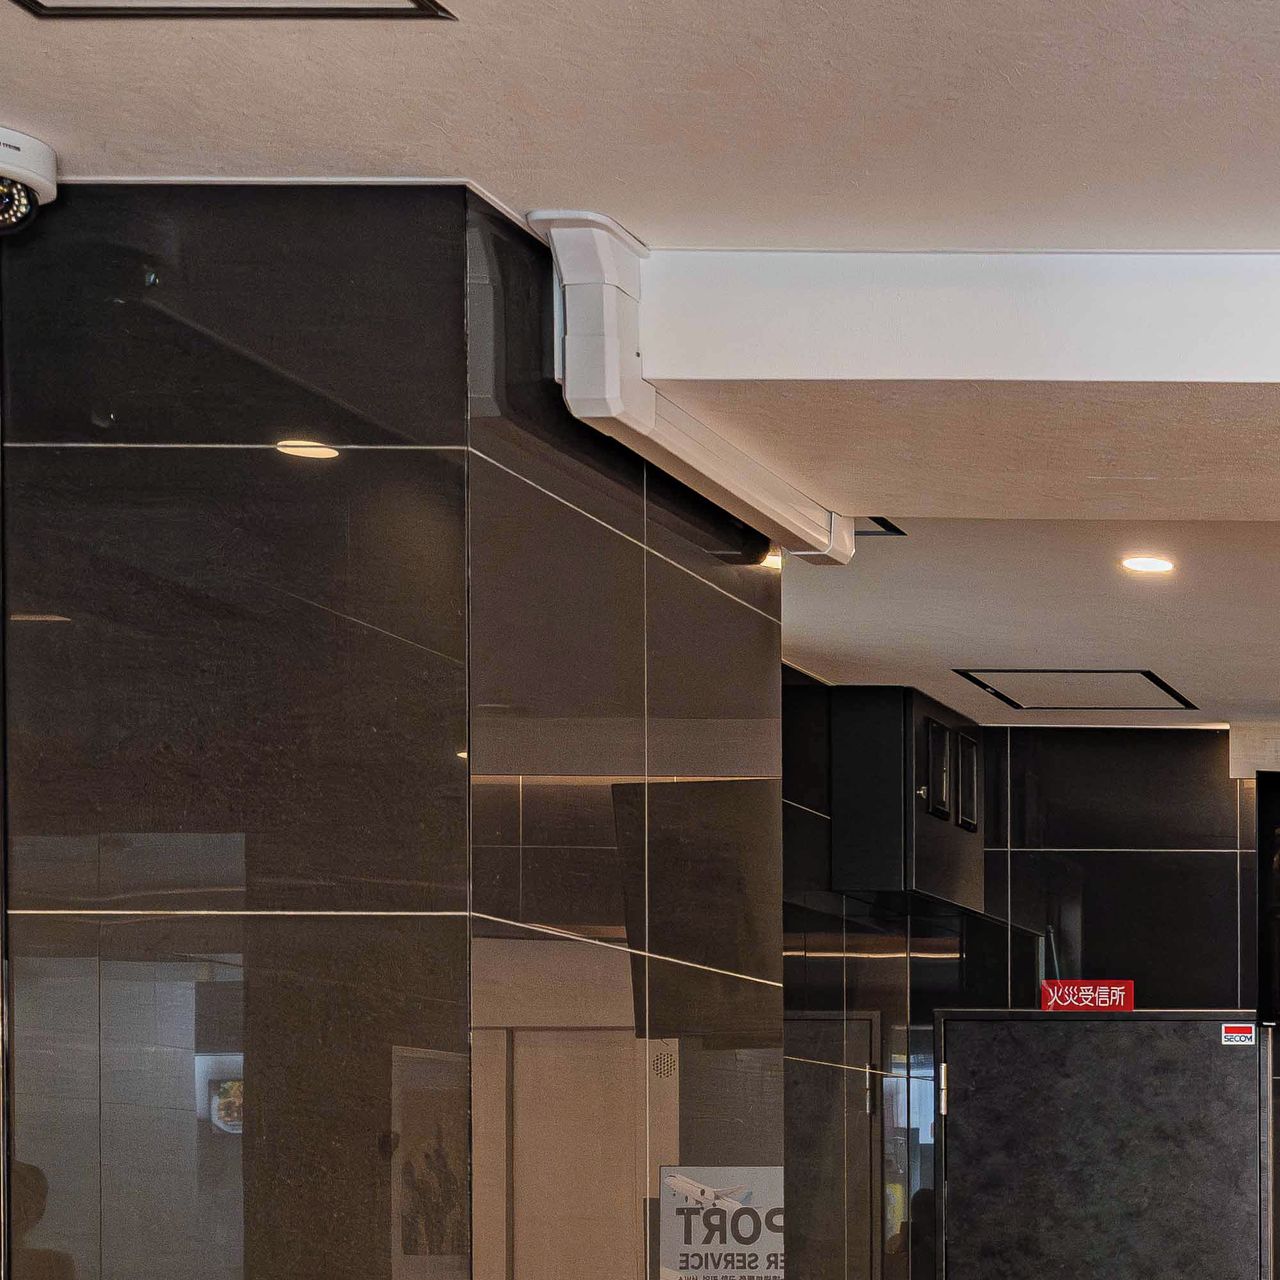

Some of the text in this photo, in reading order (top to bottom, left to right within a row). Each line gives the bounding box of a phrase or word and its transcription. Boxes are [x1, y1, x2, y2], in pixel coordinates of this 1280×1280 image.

[1047, 985, 1126, 1007] 火災受信所
[1224, 1034, 1253, 1043] SECOM
